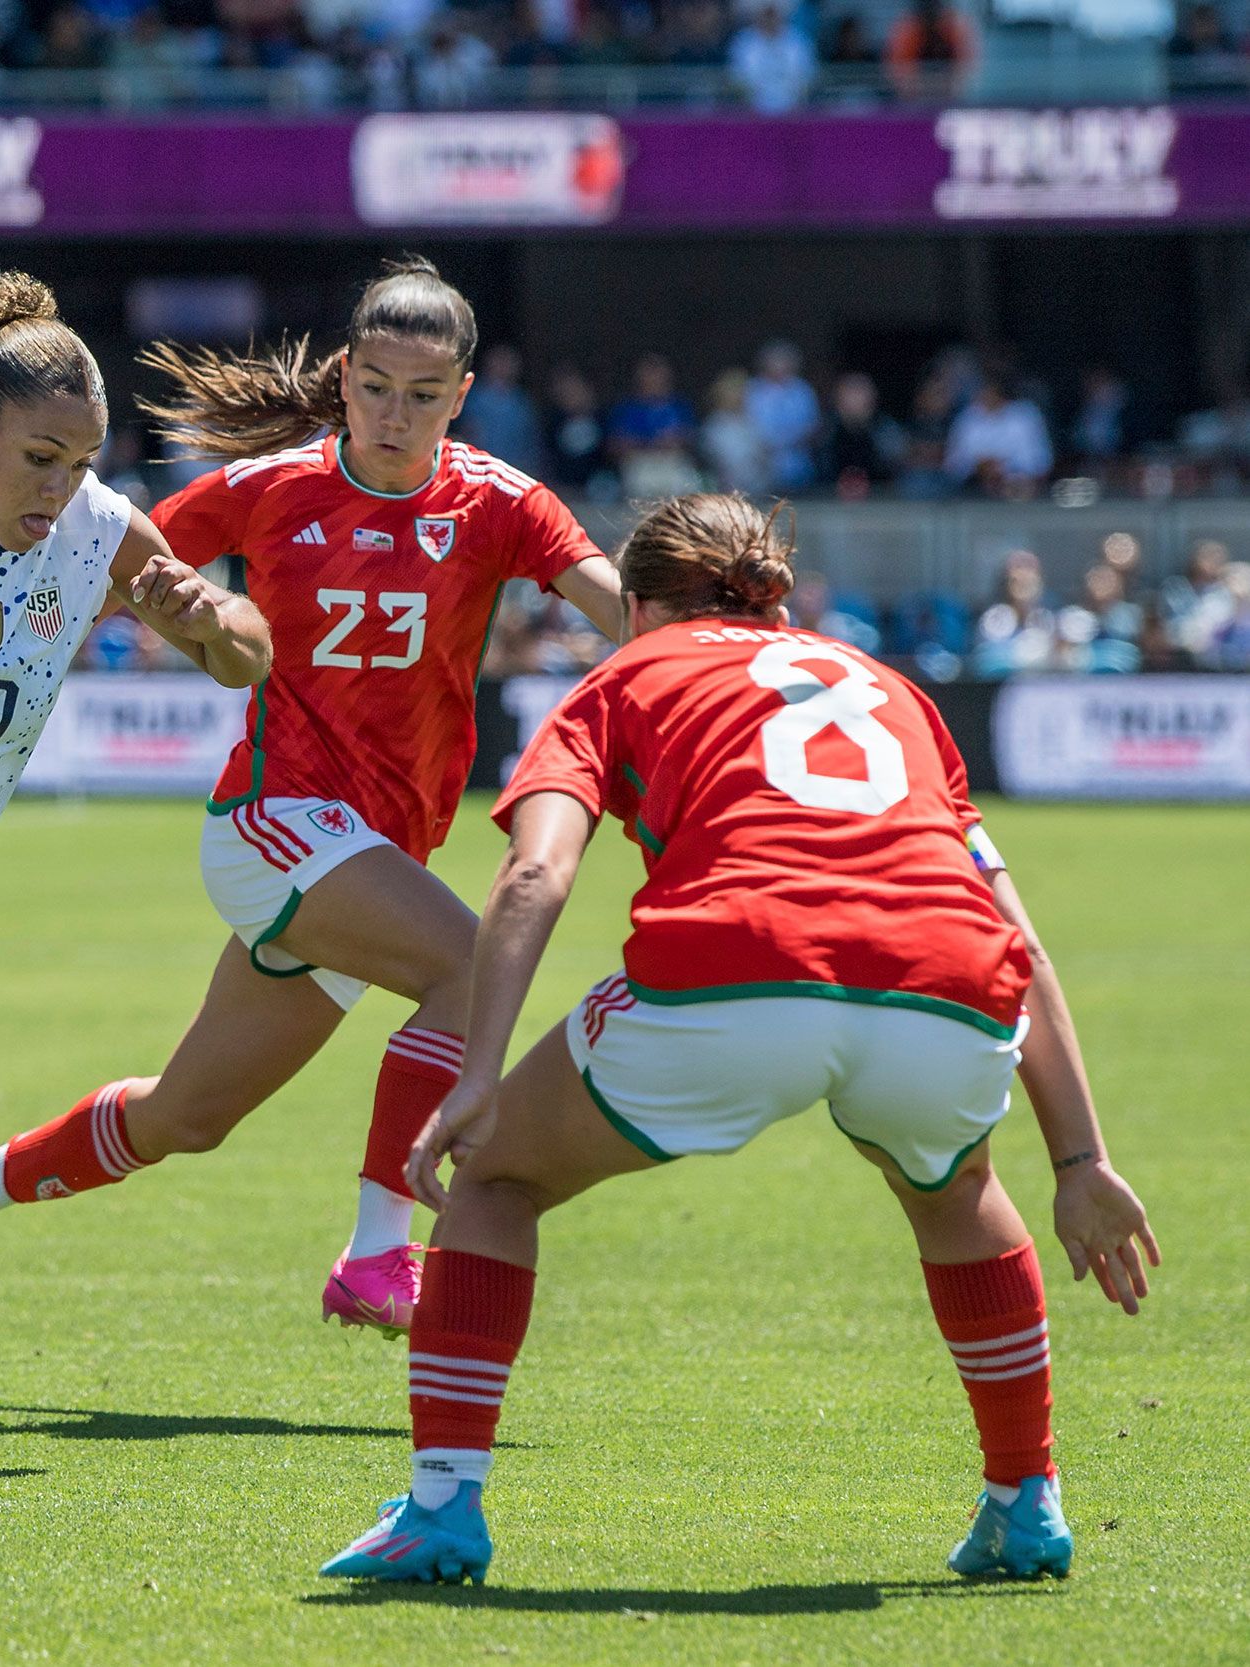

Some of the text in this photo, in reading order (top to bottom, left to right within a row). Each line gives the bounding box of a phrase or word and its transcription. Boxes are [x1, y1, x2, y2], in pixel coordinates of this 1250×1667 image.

[934, 107, 1178, 180] TRULY
[26, 590, 58, 613] USA
[311, 587, 429, 670] 23
[746, 641, 910, 817] 8
